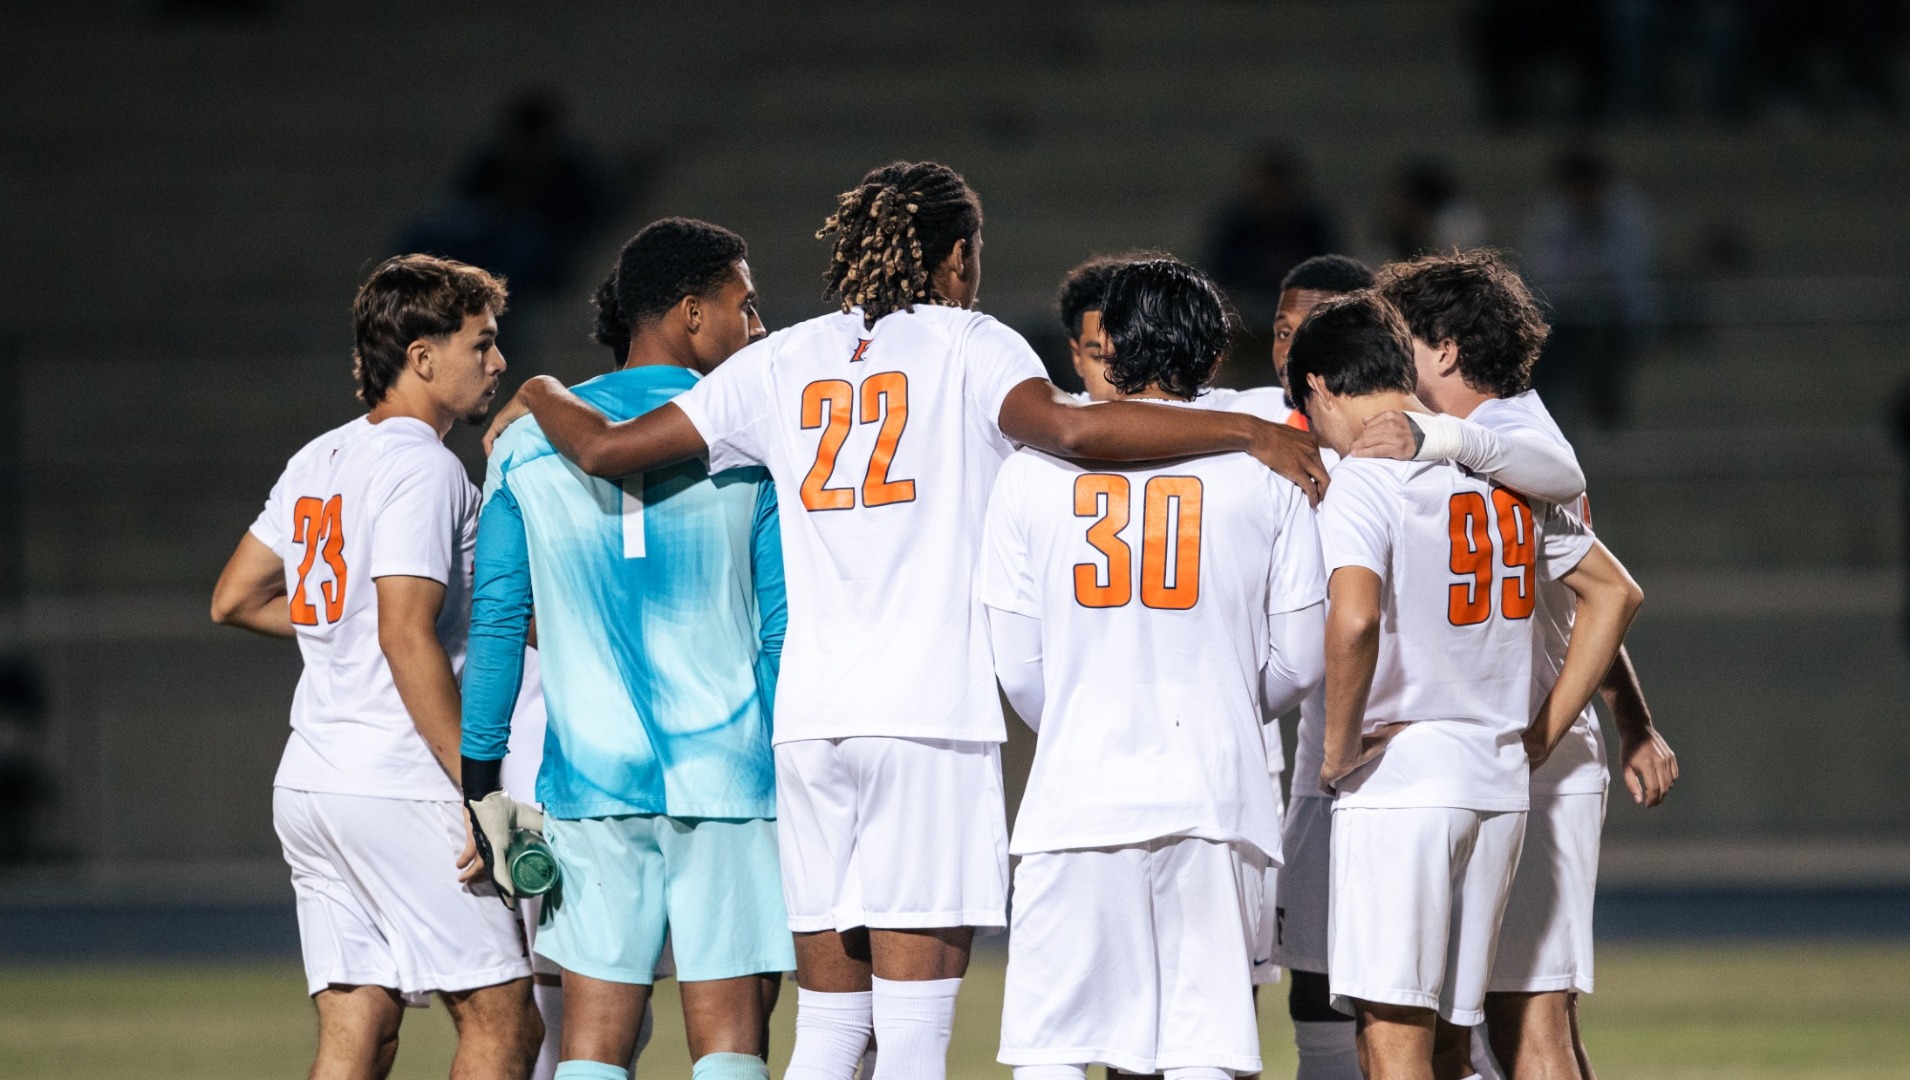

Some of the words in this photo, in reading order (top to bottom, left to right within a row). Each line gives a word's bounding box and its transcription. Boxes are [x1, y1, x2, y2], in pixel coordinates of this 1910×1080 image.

[799, 370, 917, 513] 22
[289, 493, 348, 627] 23
[1073, 473, 1204, 611] 30
[1448, 486, 1536, 627] 99
